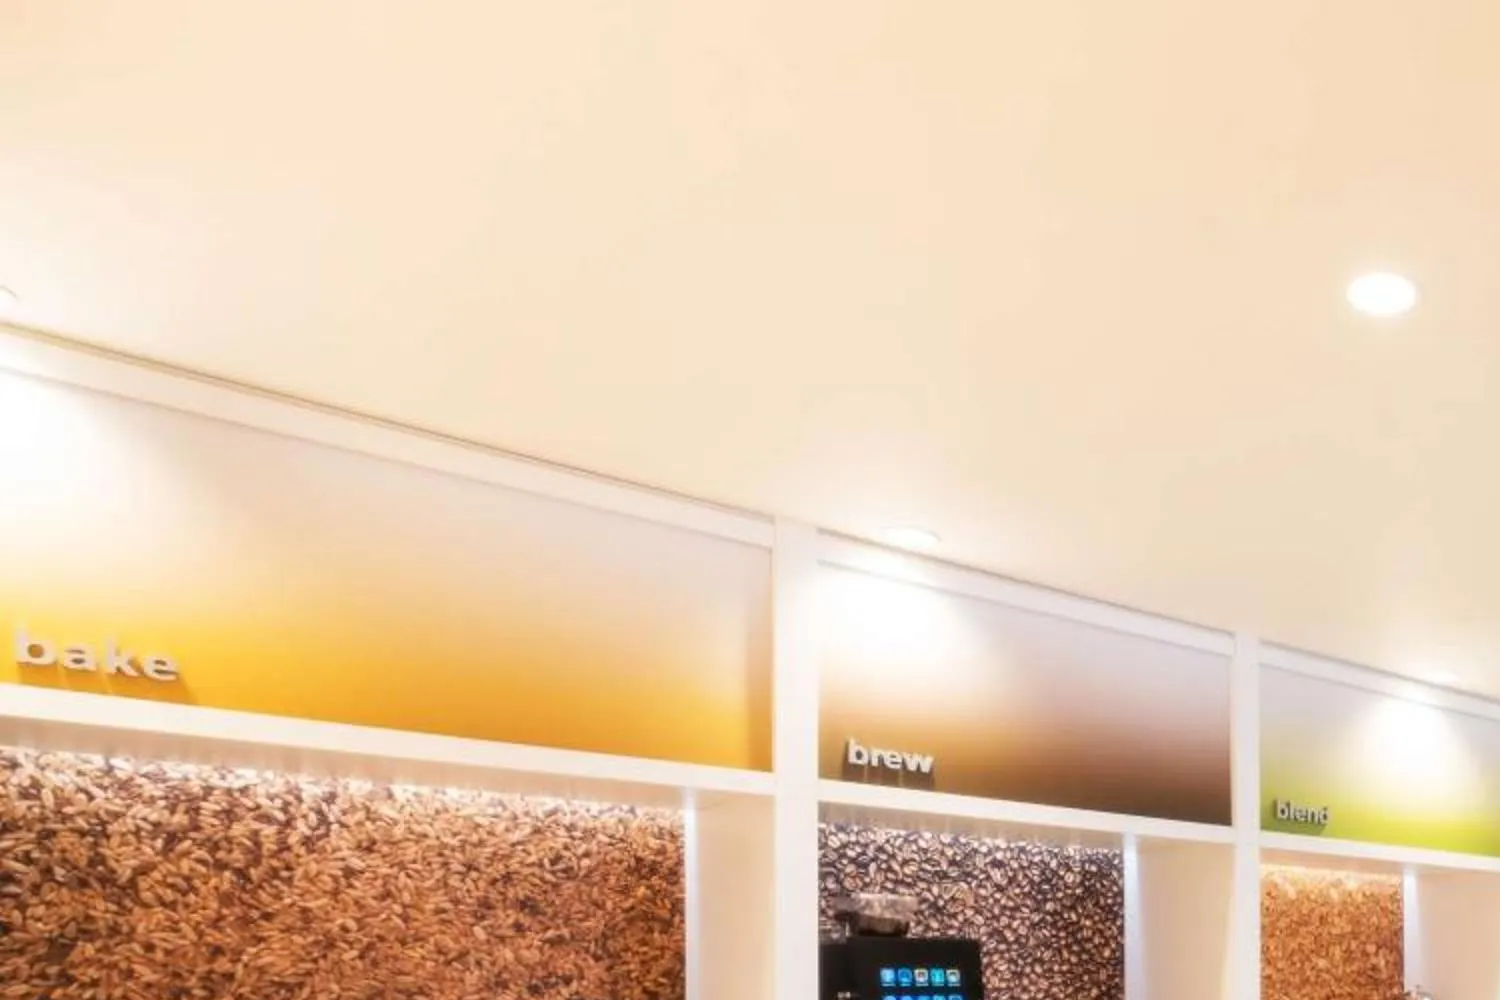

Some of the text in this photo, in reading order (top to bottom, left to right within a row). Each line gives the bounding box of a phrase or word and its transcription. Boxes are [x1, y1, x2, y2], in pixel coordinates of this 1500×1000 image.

[14, 622, 180, 681] bake
[847, 736, 934, 774] brew
[1276, 797, 1331, 825] blend
